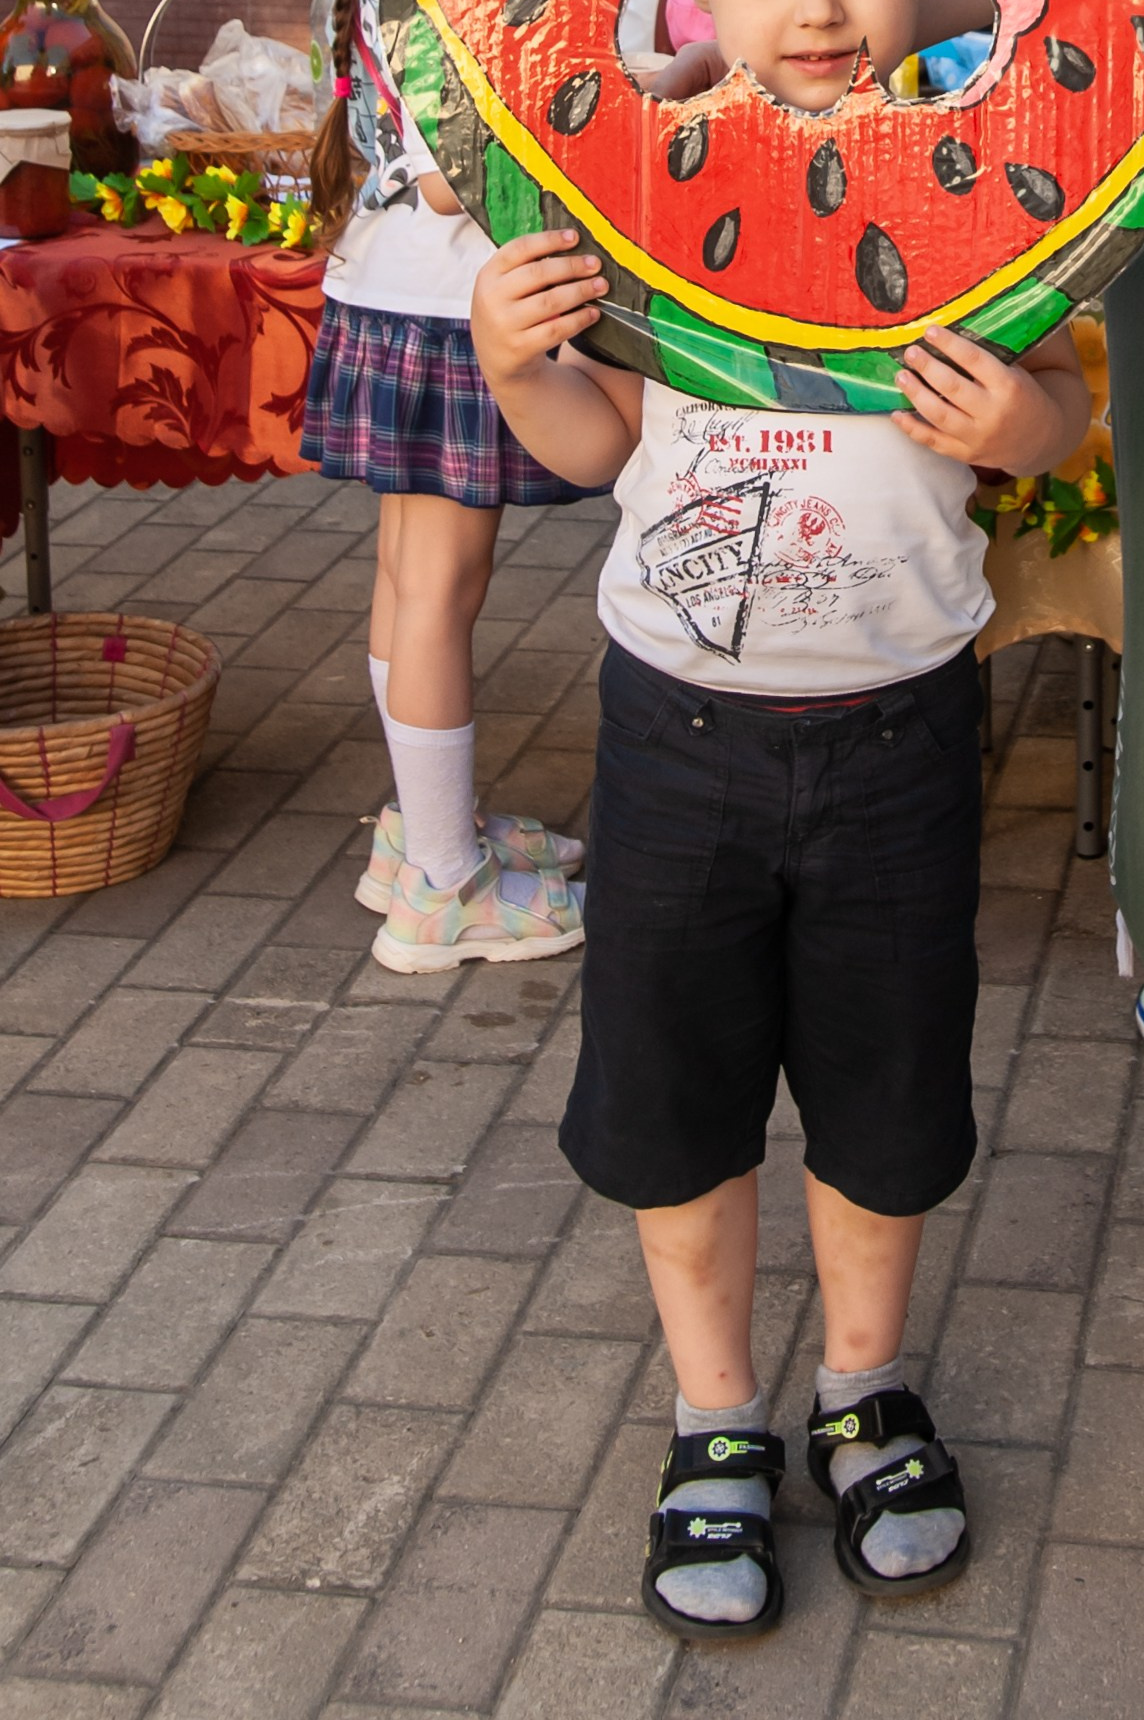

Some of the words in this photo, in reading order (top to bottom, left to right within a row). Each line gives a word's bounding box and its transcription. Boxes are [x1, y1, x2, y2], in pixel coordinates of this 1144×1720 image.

[675, 400, 737, 416] CALIFOR
[760, 429, 833, 453] 1981
[801, 498, 831, 517] JEANS
